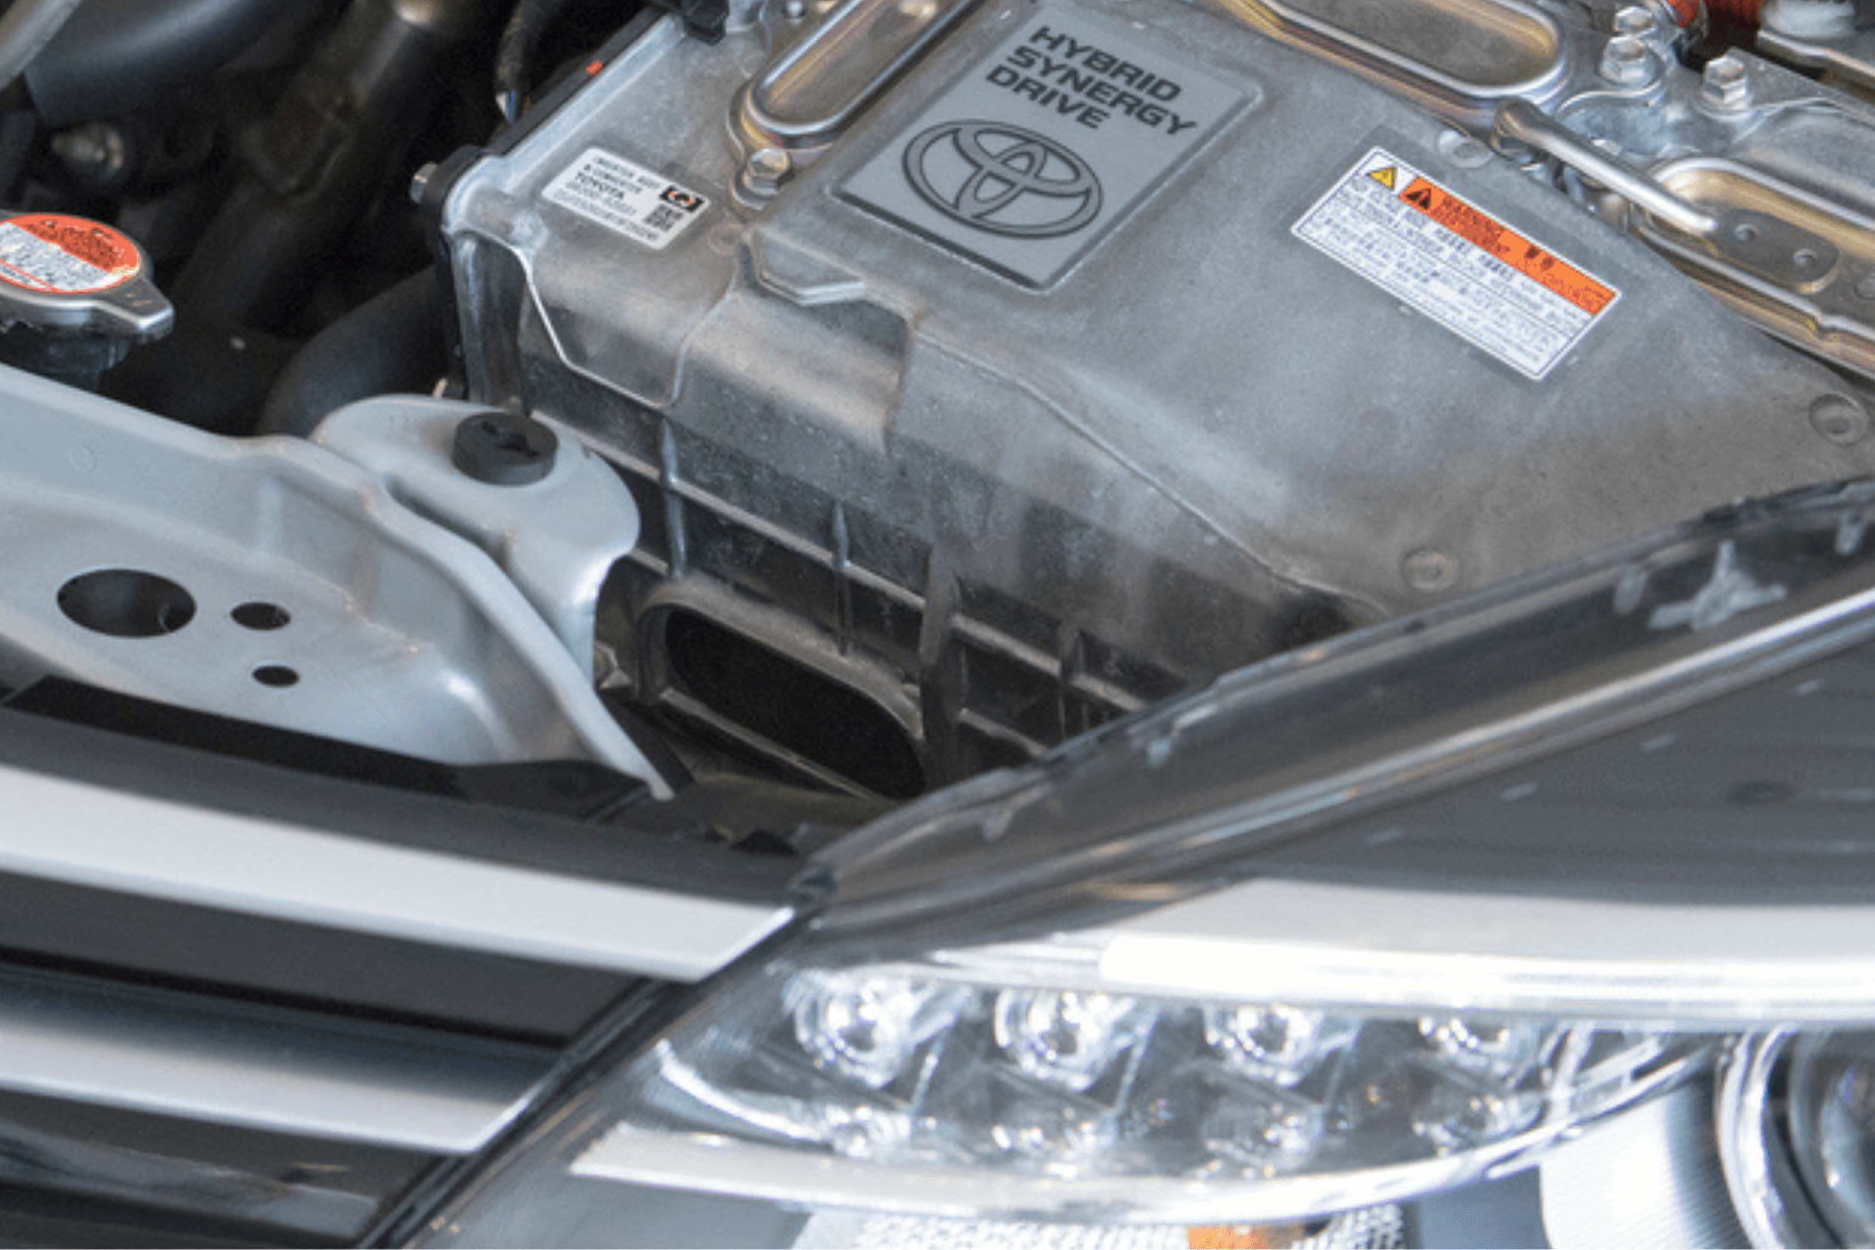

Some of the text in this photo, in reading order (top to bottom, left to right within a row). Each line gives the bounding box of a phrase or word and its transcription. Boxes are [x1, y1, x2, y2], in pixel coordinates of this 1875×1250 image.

[986, 64, 1111, 129] DRIVE
[1006, 45, 1198, 136] SYNERGY
[1029, 25, 1182, 101] HYBRID
